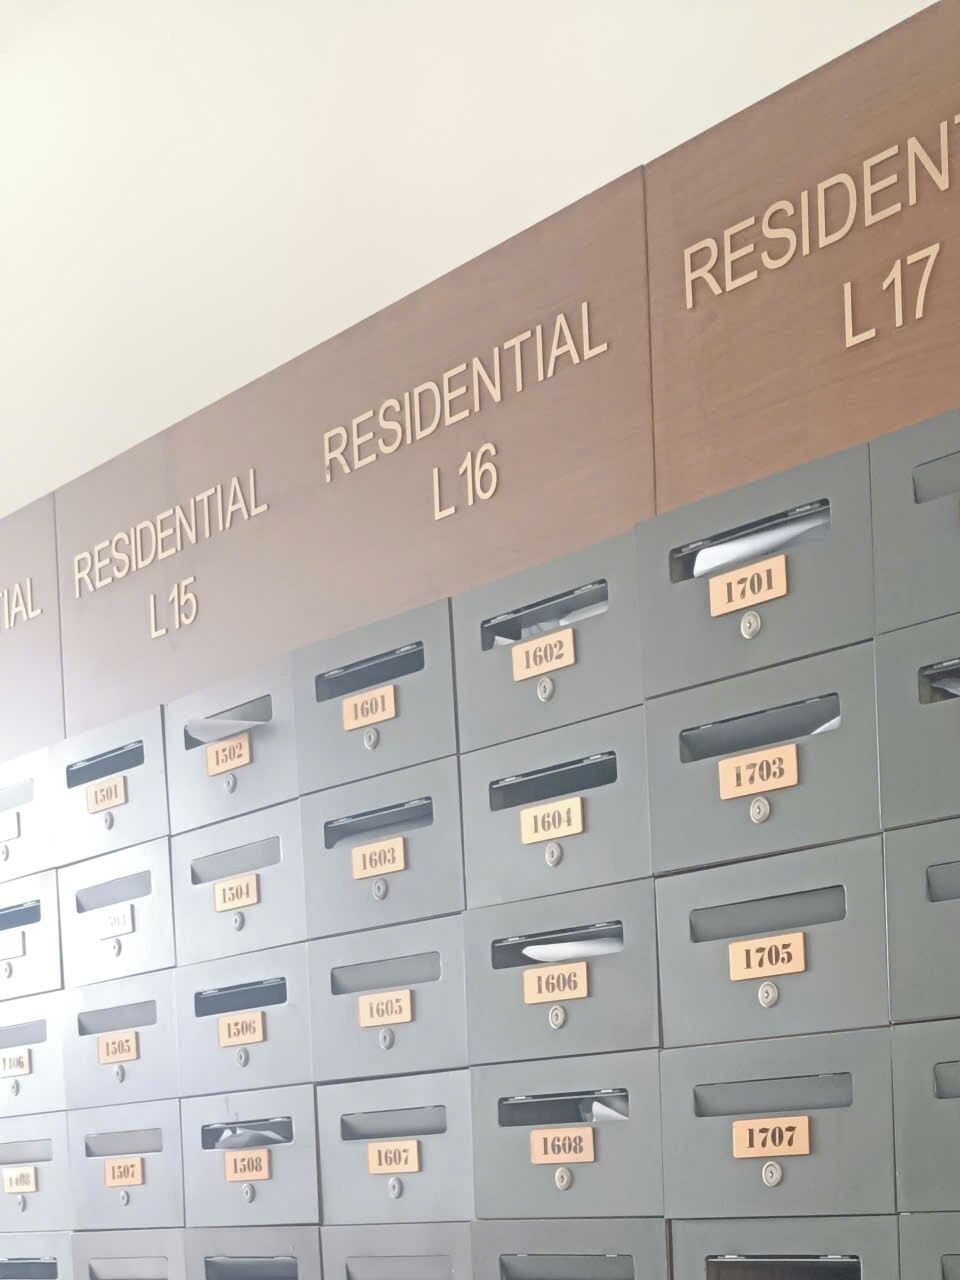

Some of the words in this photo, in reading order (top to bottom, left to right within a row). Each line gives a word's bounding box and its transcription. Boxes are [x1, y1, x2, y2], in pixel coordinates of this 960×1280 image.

[843, 281, 877, 348] L
[882, 242, 941, 329] 17
[323, 300, 609, 483] RESIDENTIAL
[432, 465, 456, 521] L
[458, 442, 499, 507] 16
[73, 467, 269, 599] RESIDENTIAL
[726, 568, 774, 604] 1701
[0, 576, 43, 630] IAL
[149, 593, 168, 639] L
[169, 575, 199, 630] 15
[524, 640, 564, 670] 1602
[353, 694, 386, 721] 1601
[215, 742, 243, 766] 1502
[735, 757, 785, 788] 1703
[94, 784, 118, 805] 1501
[533, 807, 572, 834] 1604
[362, 847, 396, 871] 1603
[745, 944, 793, 970] 1705
[537, 971, 578, 995] 1606
[369, 999, 403, 1018] 1605
[227, 1021, 257, 1039] 1506
[106, 1040, 131, 1057] 1505
[543, 1135, 584, 1156] 1608
[748, 1126, 794, 1149] 1707
[233, 1156, 263, 1174] 1508
[377, 1149, 409, 1167] 1607
[111, 1164, 135, 1180] 1507
